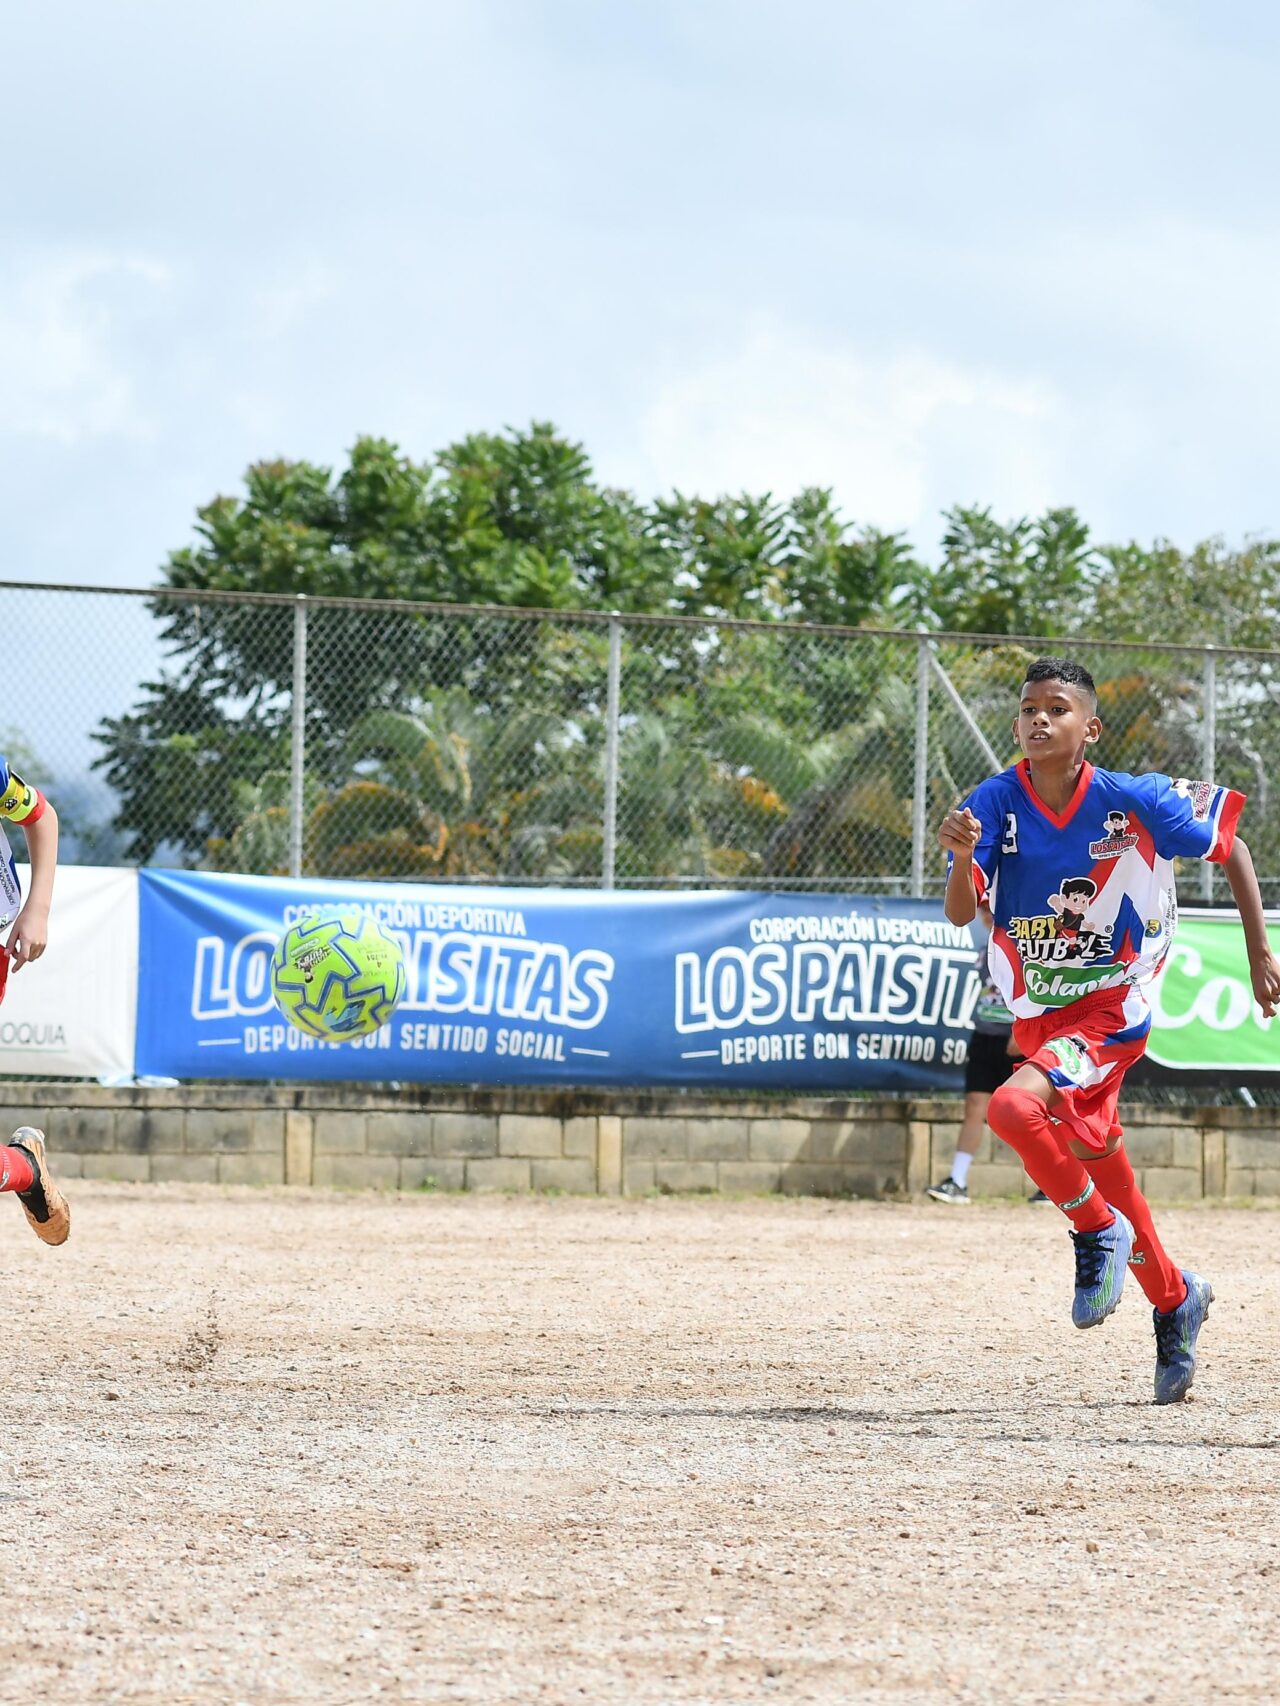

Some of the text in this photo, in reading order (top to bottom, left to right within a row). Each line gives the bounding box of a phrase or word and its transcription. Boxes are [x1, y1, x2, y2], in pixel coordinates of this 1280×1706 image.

[1001, 813, 1018, 854] 3
[283, 899, 527, 936] COACIÓN DEPORTIVA
[750, 911, 975, 949] CORPORACIÓN DEPORTIVA
[1018, 934, 1096, 960] FÚTBL
[191, 930, 615, 1030] LO ISITAS
[675, 942, 983, 1033] LOS PAISIT
[1025, 968, 1111, 996] Colan
[0, 1022, 66, 1045] OQUIA
[244, 1023, 341, 1054] DEPOR
[400, 1022, 488, 1053] SENTIDO
[495, 1027, 566, 1062] SOCIAL
[721, 1031, 806, 1066] DEPORTE
[813, 1033, 850, 1060] CON
[856, 1033, 936, 1063] SENTIDO
